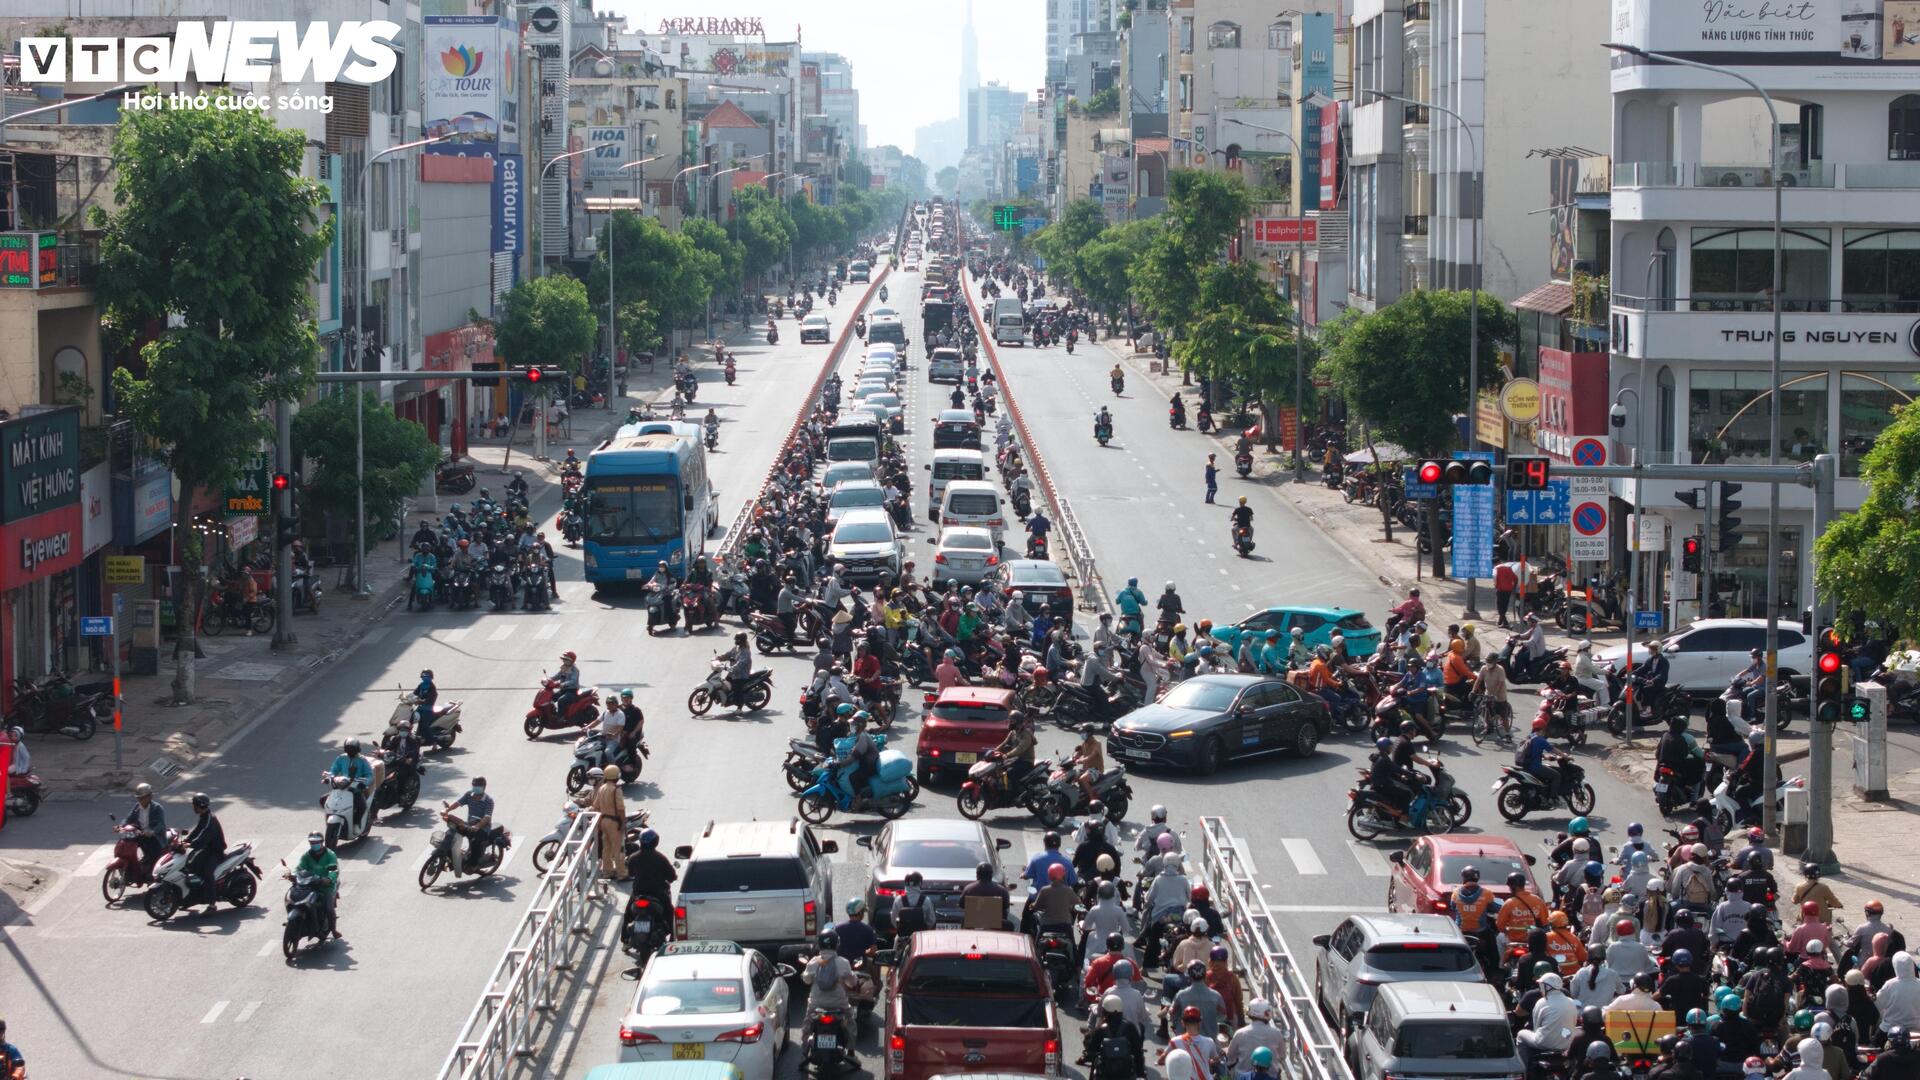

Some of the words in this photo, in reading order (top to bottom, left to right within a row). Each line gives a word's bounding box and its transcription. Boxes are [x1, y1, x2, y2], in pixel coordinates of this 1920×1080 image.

[1759, 1, 1815, 20] biệt
[1701, 29, 1727, 40] NĂNG
[1730, 30, 1761, 42] LƯỢNG
[1789, 28, 1815, 40] THỨC
[592, 130, 625, 141] HOA
[503, 159, 519, 251] cattour.vn
[1806, 331, 1897, 343] NGUYEN
[39, 428, 63, 460] KÍNH
[1528, 461, 1545, 486] 4
[22, 473, 43, 510] VIỆT
[45, 468, 74, 498] HƯNG
[23, 531, 71, 572] Eyewear
